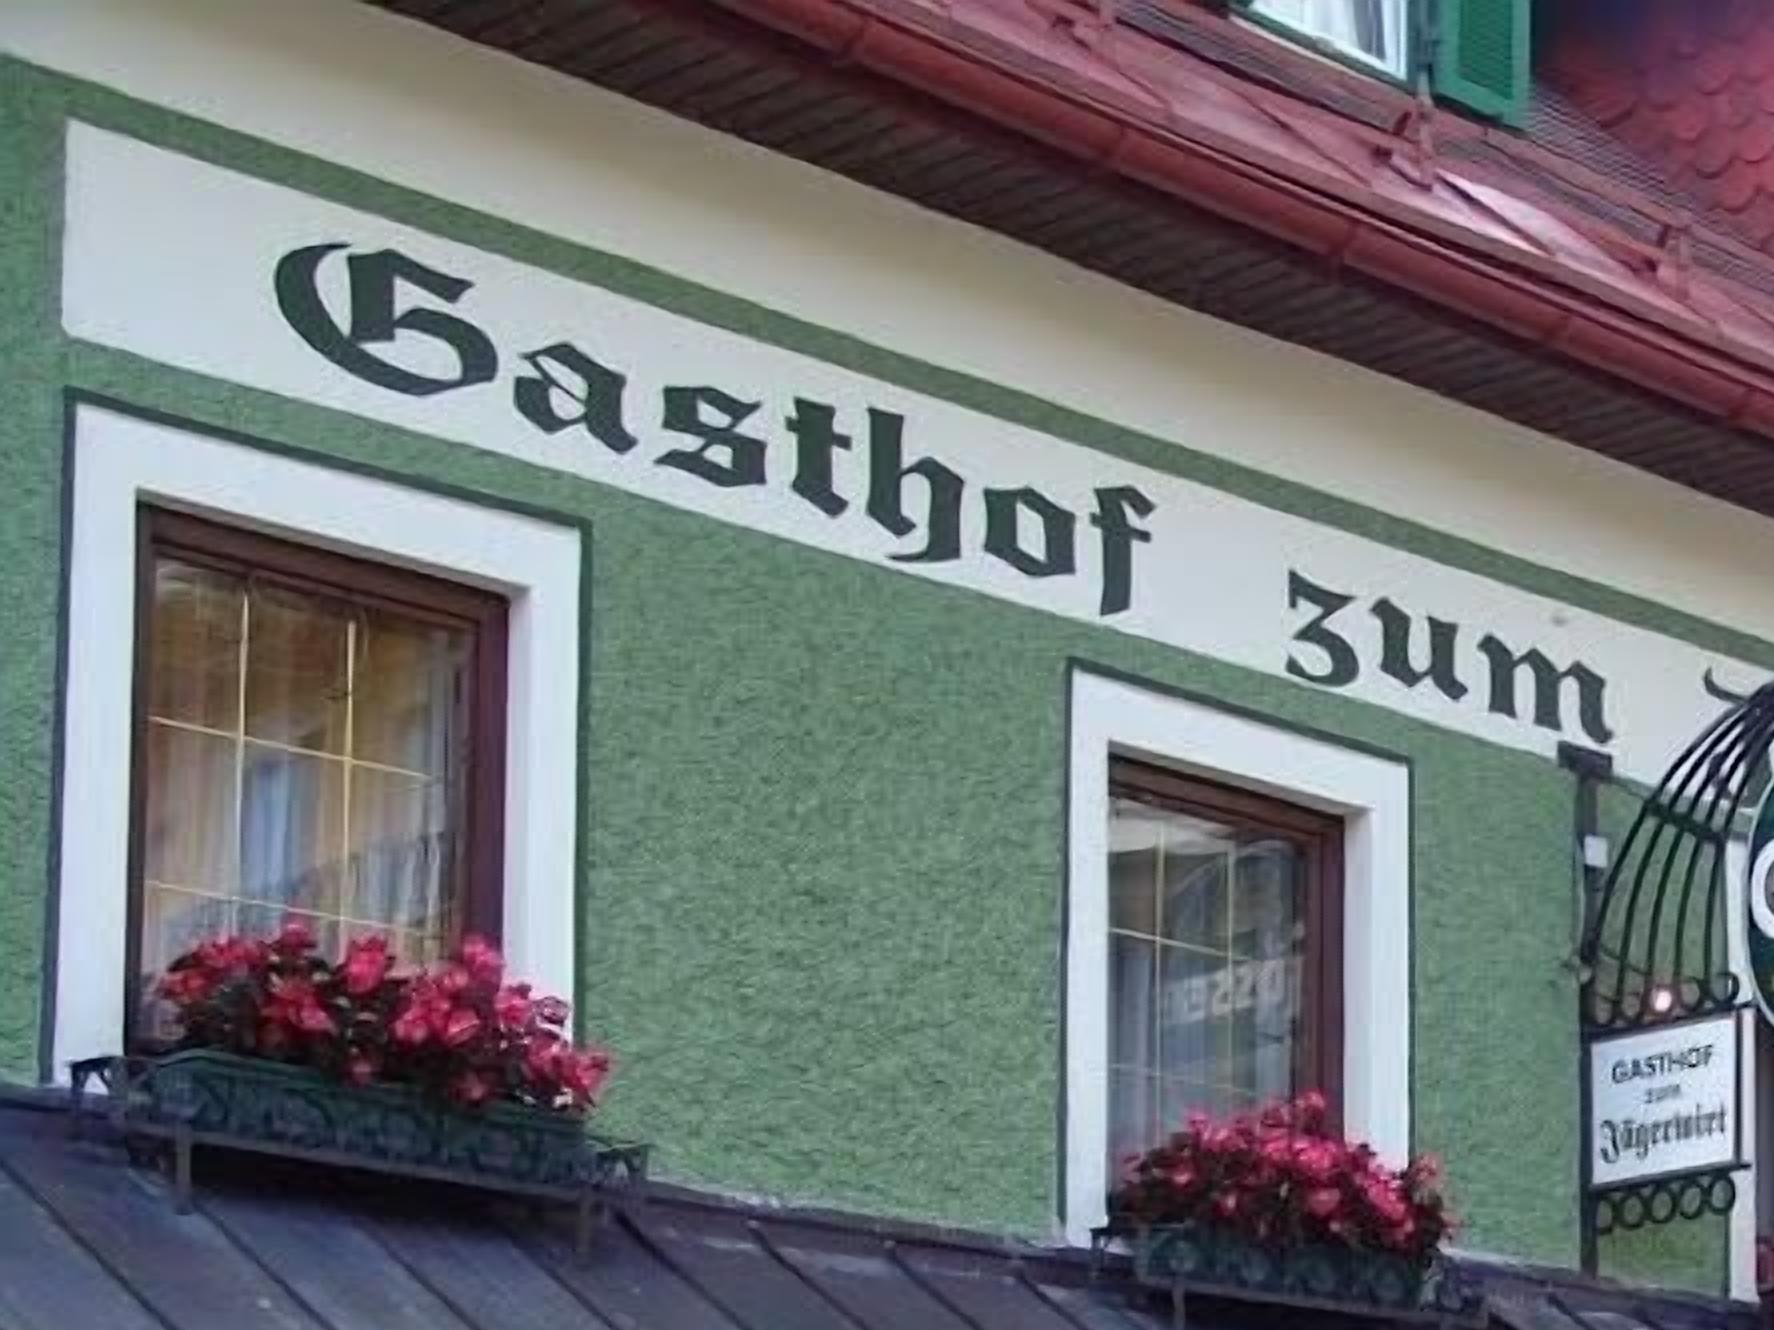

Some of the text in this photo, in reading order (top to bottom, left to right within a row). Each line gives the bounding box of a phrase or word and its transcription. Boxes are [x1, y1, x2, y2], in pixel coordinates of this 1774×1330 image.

[273, 241, 1155, 616] Gasthof
[1284, 568, 1615, 744] zum
[1611, 1043, 1714, 1084] GASTHOF
[1599, 1102, 1727, 1164] Jägerwirt
